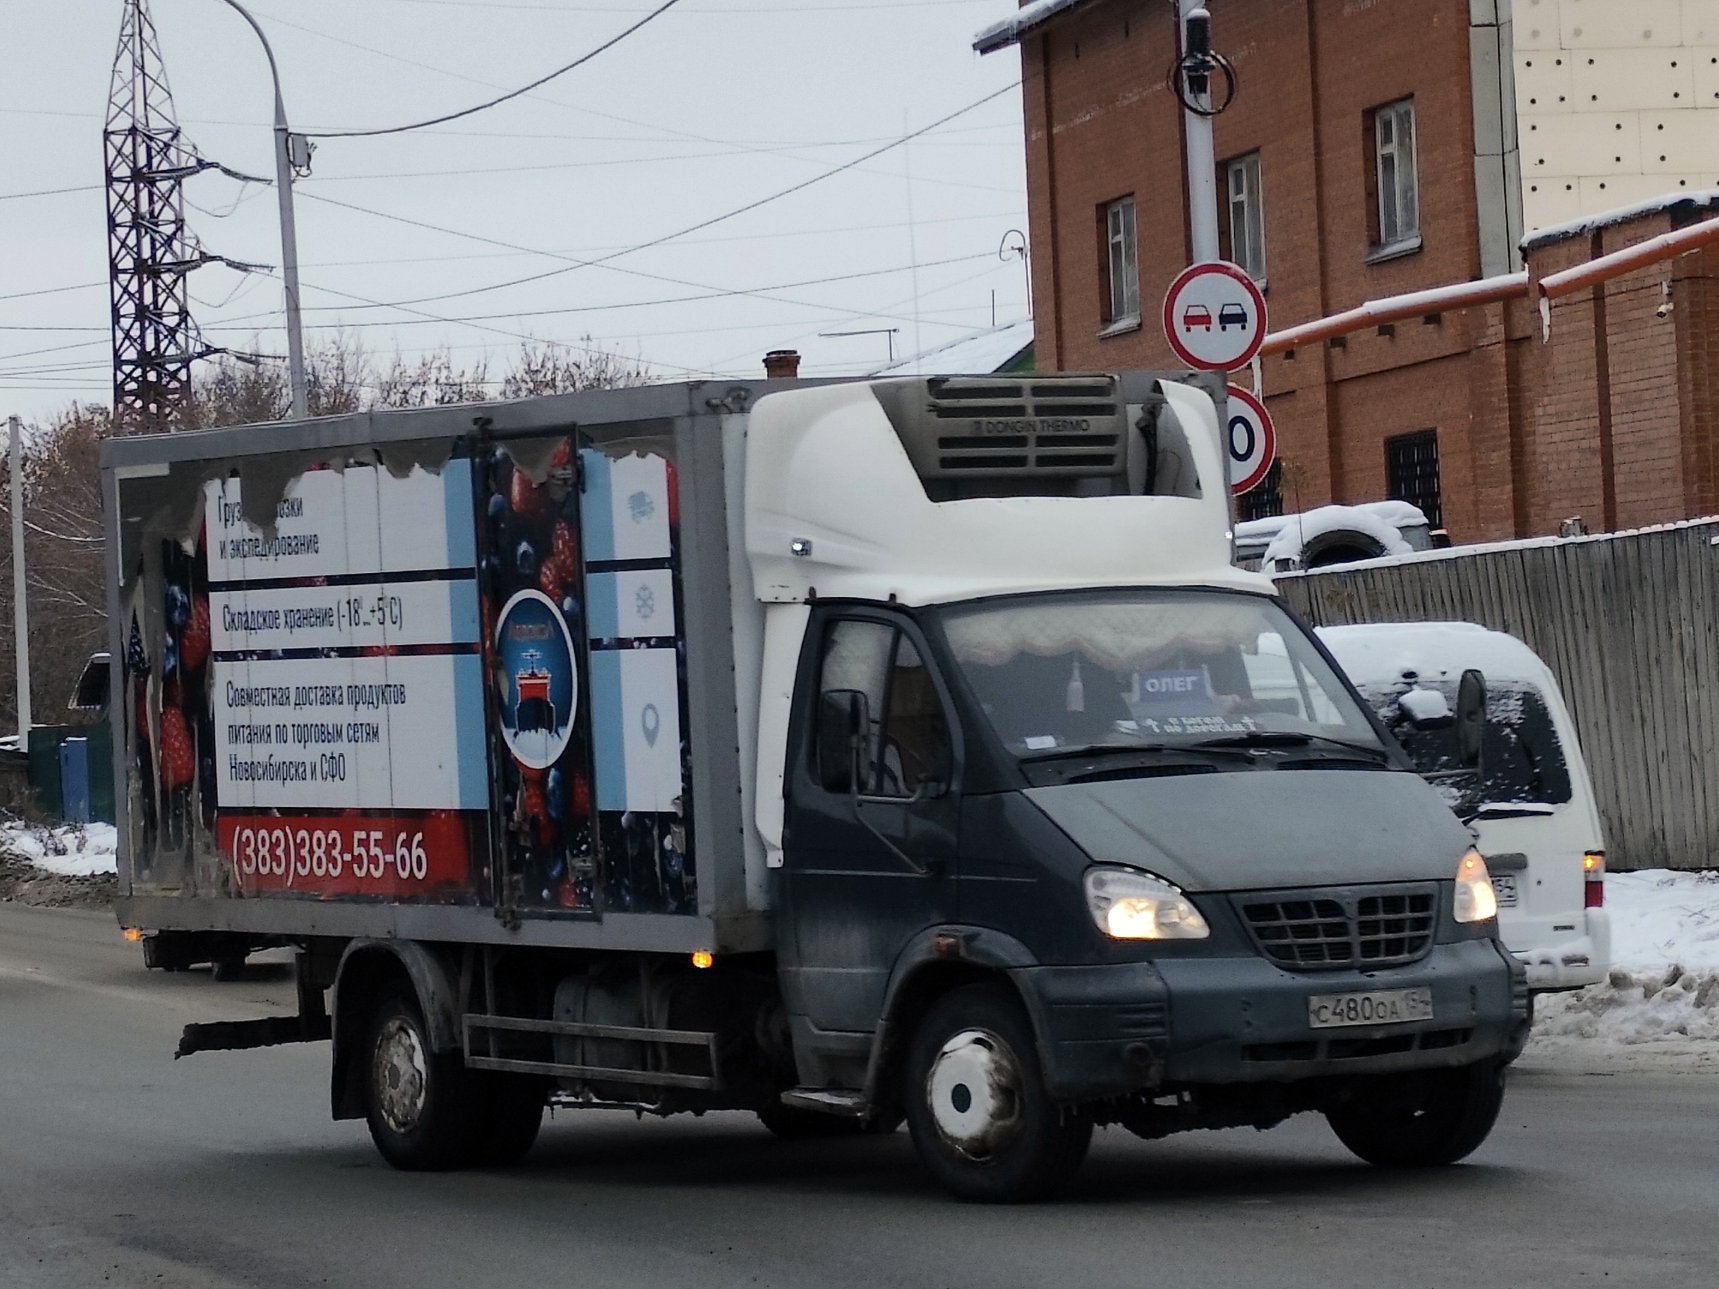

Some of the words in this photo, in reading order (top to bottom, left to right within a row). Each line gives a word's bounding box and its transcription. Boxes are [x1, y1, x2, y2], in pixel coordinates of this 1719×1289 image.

[985, 420, 1037, 434] DONGIN
[1039, 418, 1091, 432] THERMO
[1229, 415, 1256, 463] 0
[219, 540, 227, 560] и
[230, 534, 320, 562] экспедирование
[222, 603, 281, 636] Складское
[283, 606, 334, 635] хранение
[226, 680, 291, 708] Совместная
[293, 685, 344, 711] доставка
[347, 684, 407, 712] продуктов
[1146, 676, 1198, 693] ОЛЕГ
[228, 723, 272, 745] питания
[275, 723, 288, 744] по
[291, 722, 343, 749] торговым
[346, 722, 380, 744] сетям
[229, 753, 307, 789] Новосибирска
[310, 761, 317, 782] и
[319, 751, 346, 783] СФО
[233, 825, 427, 887] (383)383-55-66
